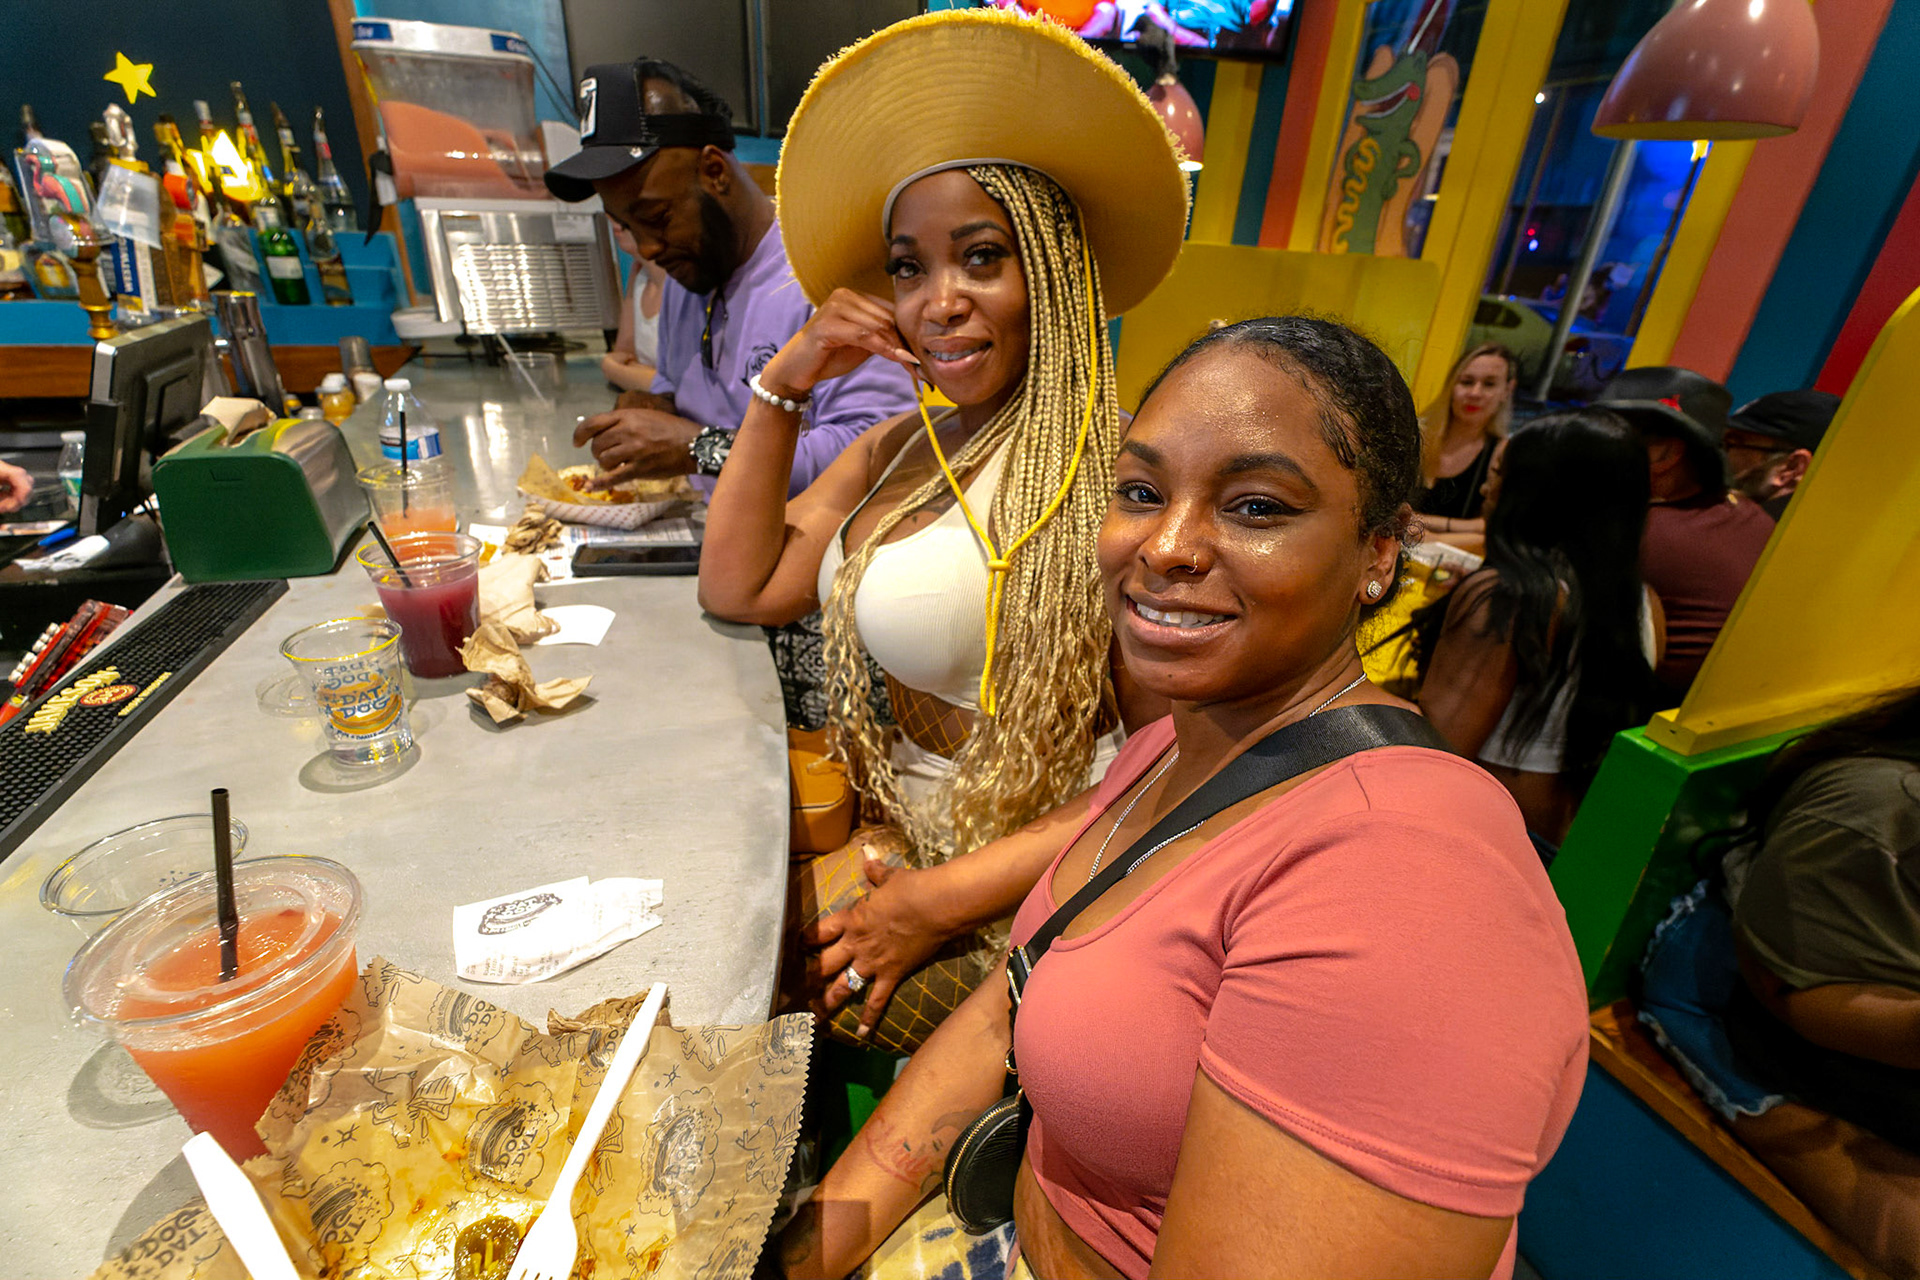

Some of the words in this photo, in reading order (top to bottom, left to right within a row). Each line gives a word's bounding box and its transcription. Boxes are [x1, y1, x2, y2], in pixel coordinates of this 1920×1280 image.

[25, 669, 121, 735] JAMESON
[340, 685, 382, 706] DAT
[339, 697, 391, 719] DOG
